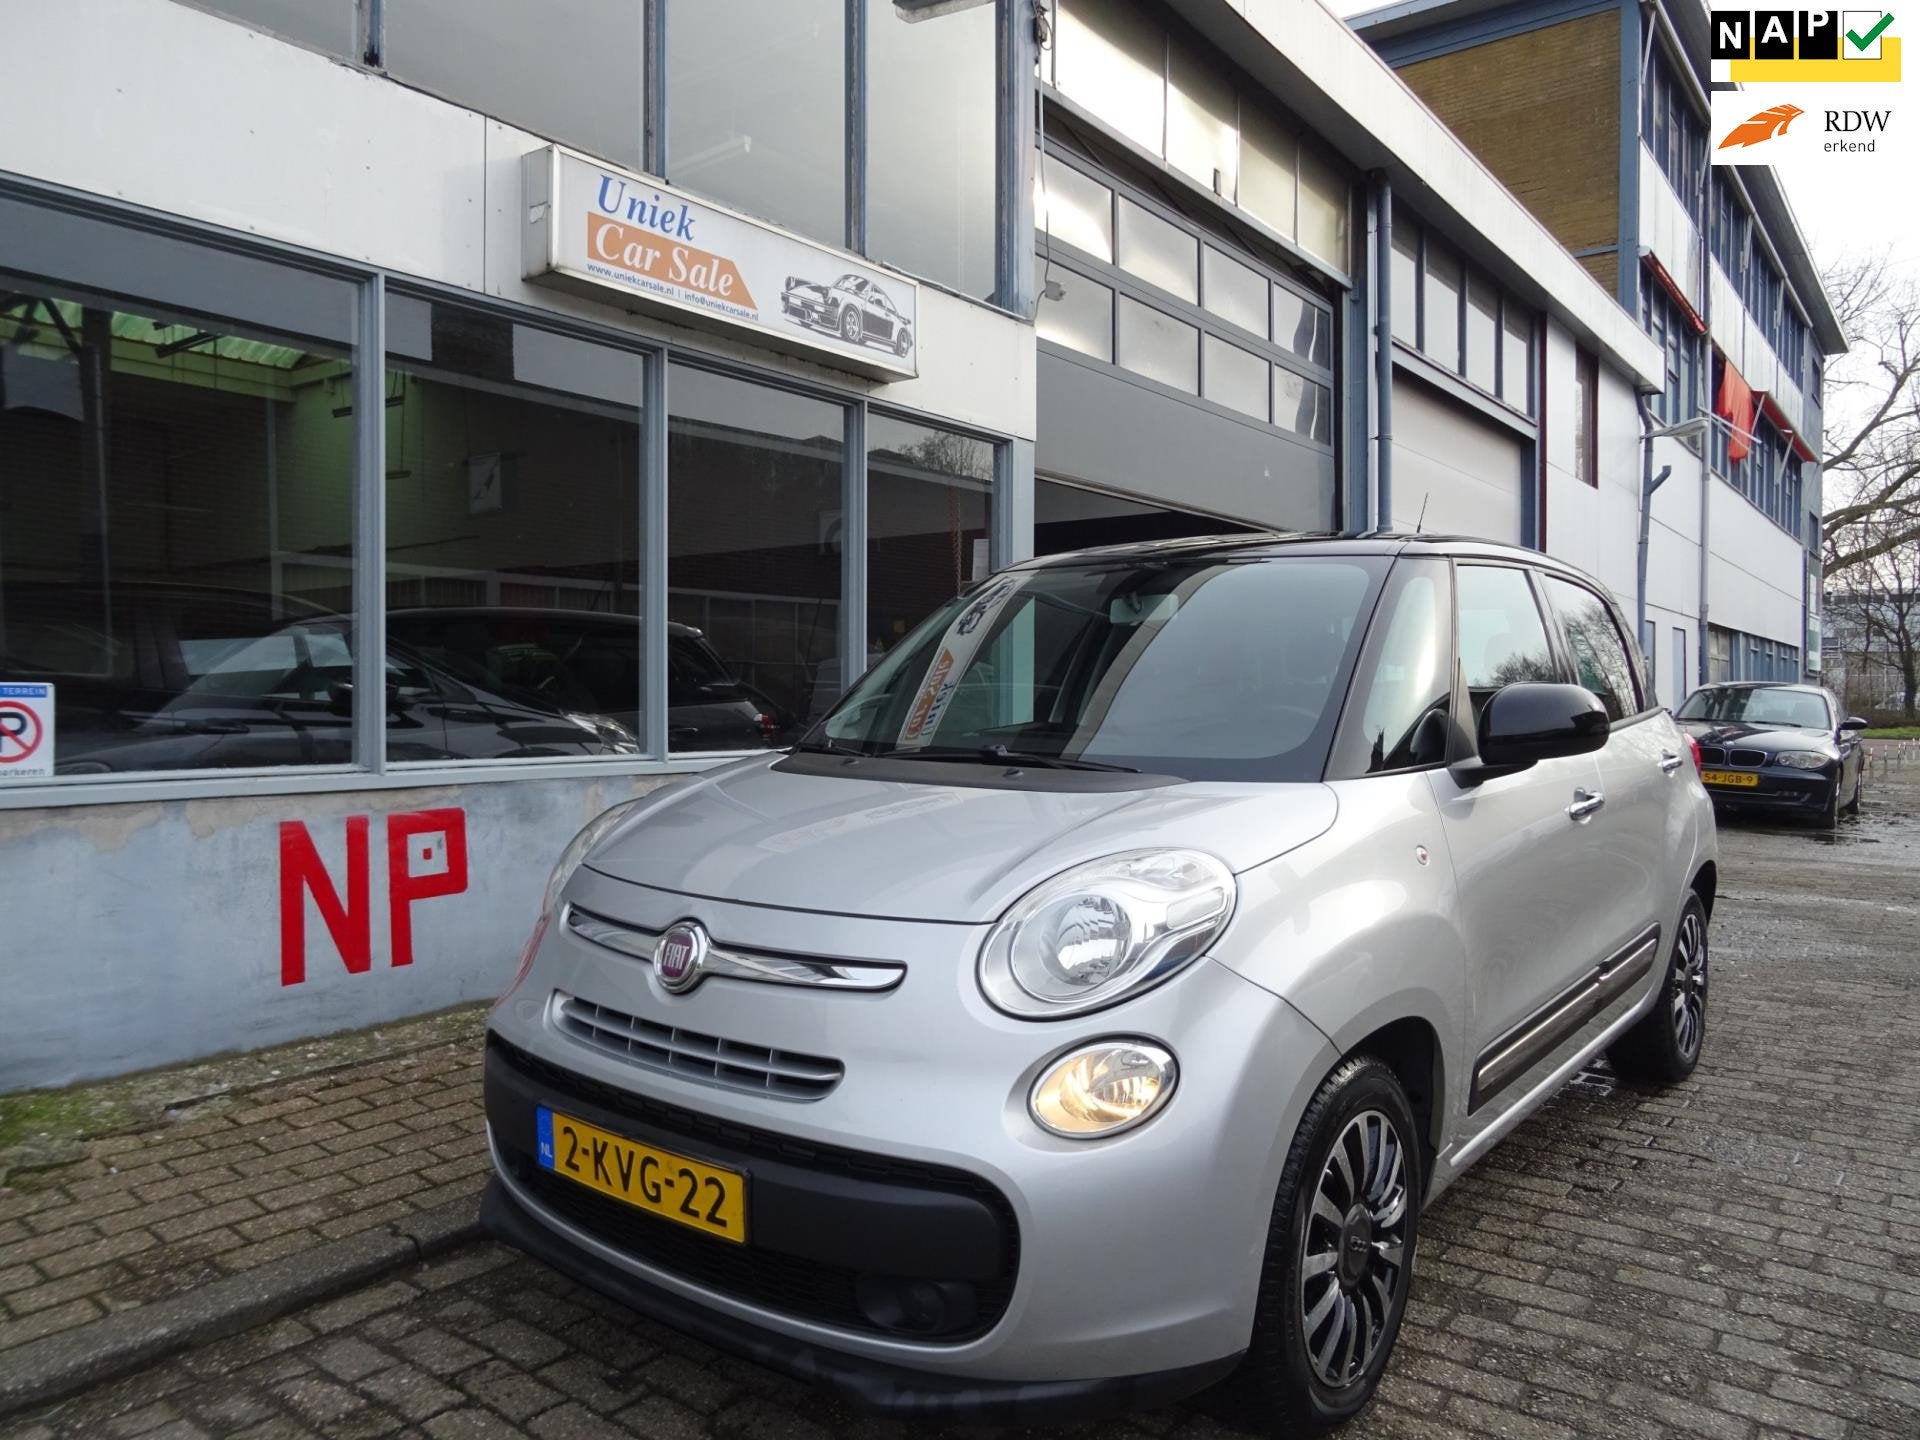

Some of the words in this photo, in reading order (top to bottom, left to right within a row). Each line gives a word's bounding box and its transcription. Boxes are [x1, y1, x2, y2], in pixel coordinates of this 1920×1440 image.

[598, 174, 696, 241] Uniek
[595, 223, 661, 272] Car
[668, 247, 734, 296] Sale
[587, 263, 675, 295] www.uniekcarsale.nl
[684, 292, 759, 321] info@uniekcarsale.nl
[3, 687, 46, 695] TERREIN
[279, 806, 469, 988] NP
[663, 943, 690, 970] FIAT
[541, 1141, 553, 1158] NL
[562, 1125, 728, 1228] 2-KVG-22
